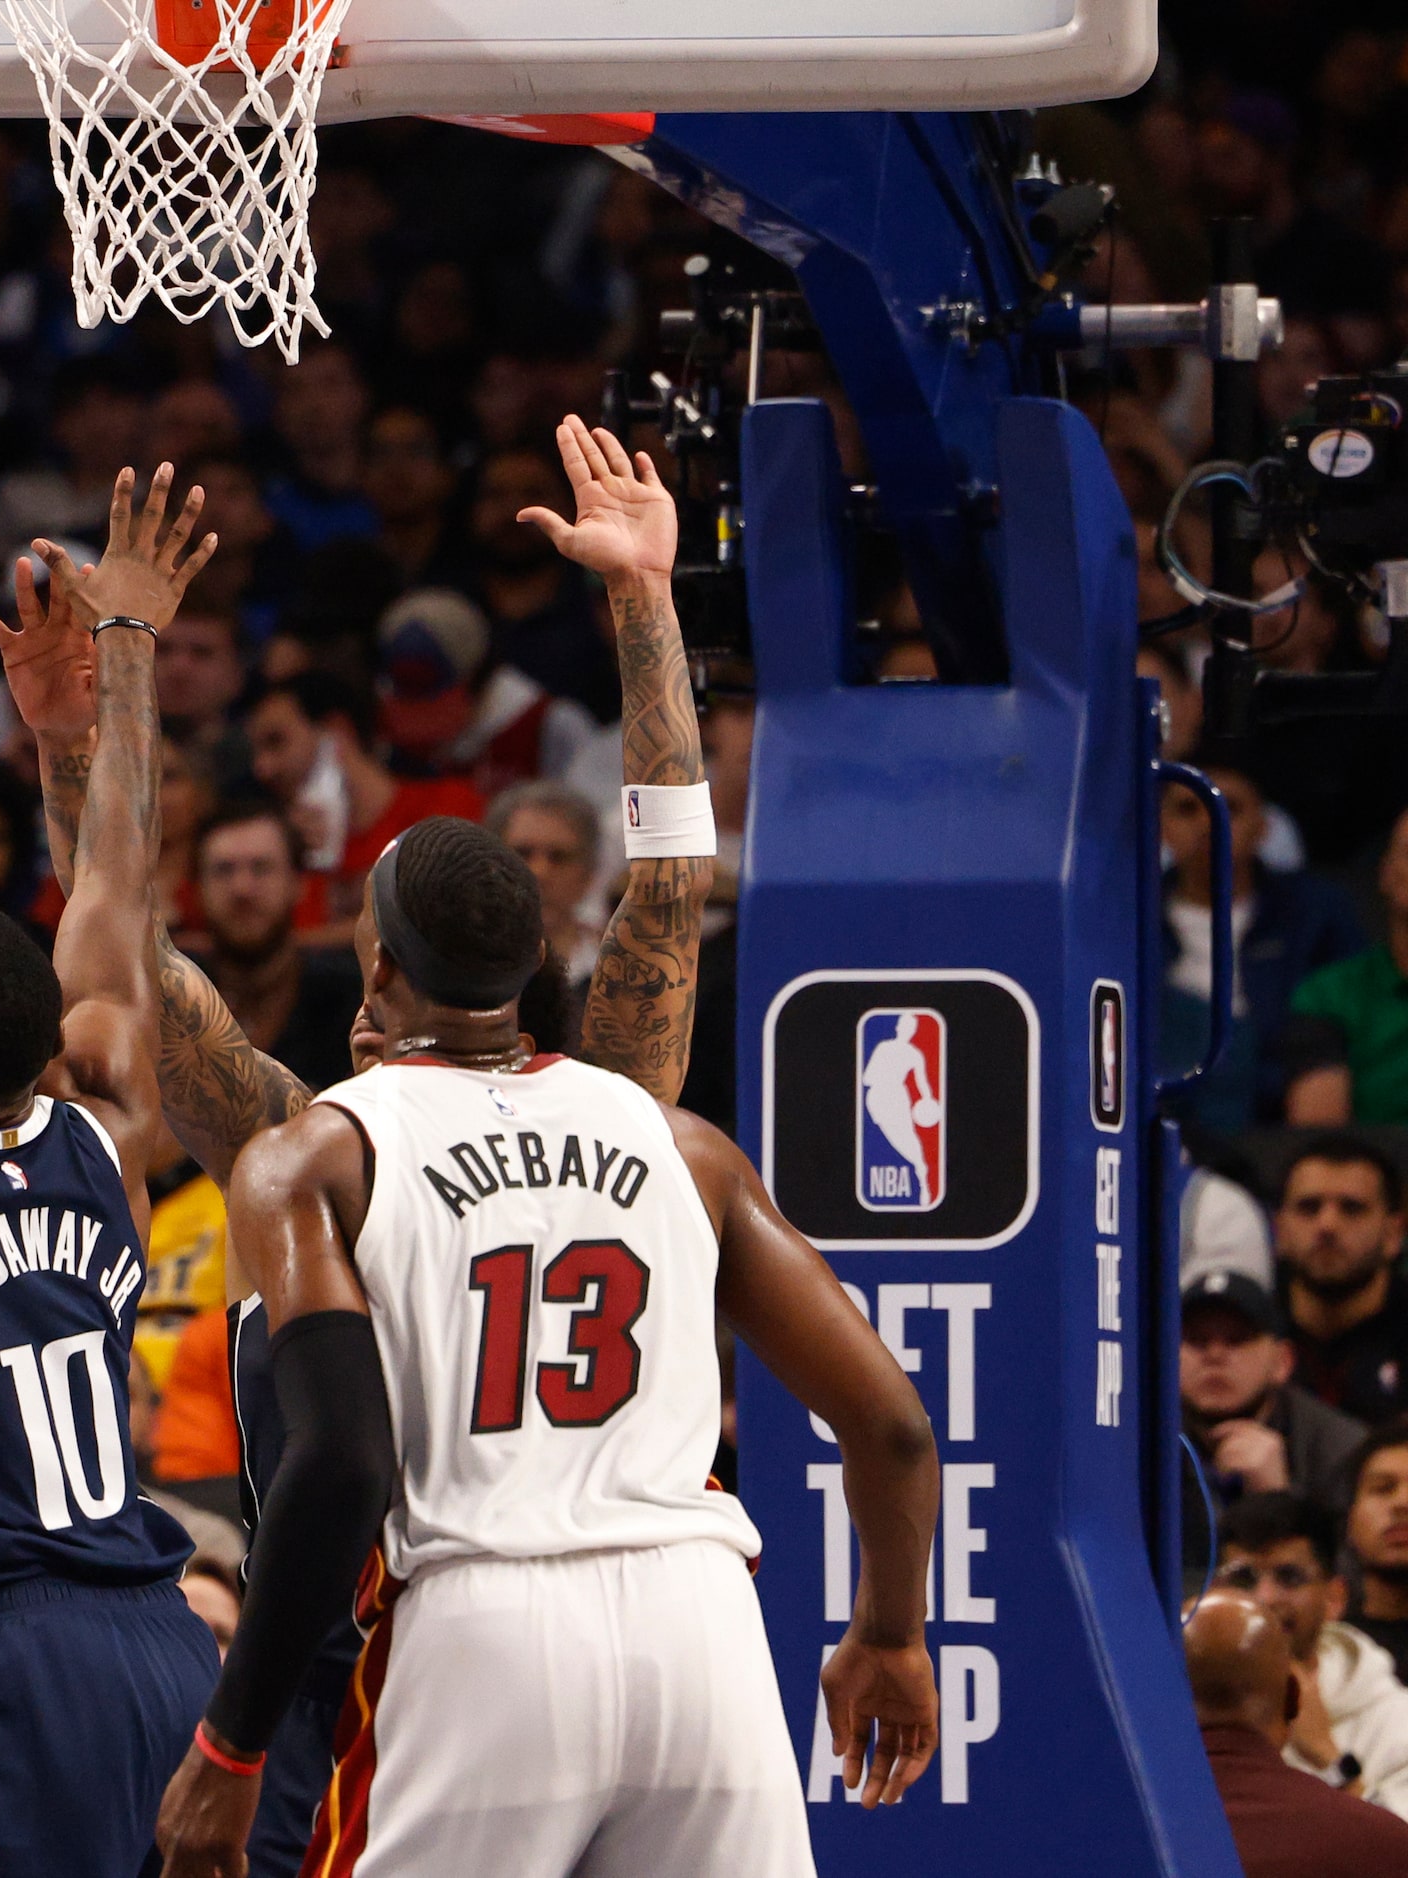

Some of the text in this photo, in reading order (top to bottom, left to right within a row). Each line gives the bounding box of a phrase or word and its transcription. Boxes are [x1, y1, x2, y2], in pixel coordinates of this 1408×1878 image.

[422, 1131, 650, 1221] ADEBAYO
[869, 1165, 913, 1199] NBA
[99, 1245, 143, 1331] JR.
[468, 1238, 652, 1435] 13
[808, 1282, 993, 1443] ET
[806, 1462, 997, 1624] TE
